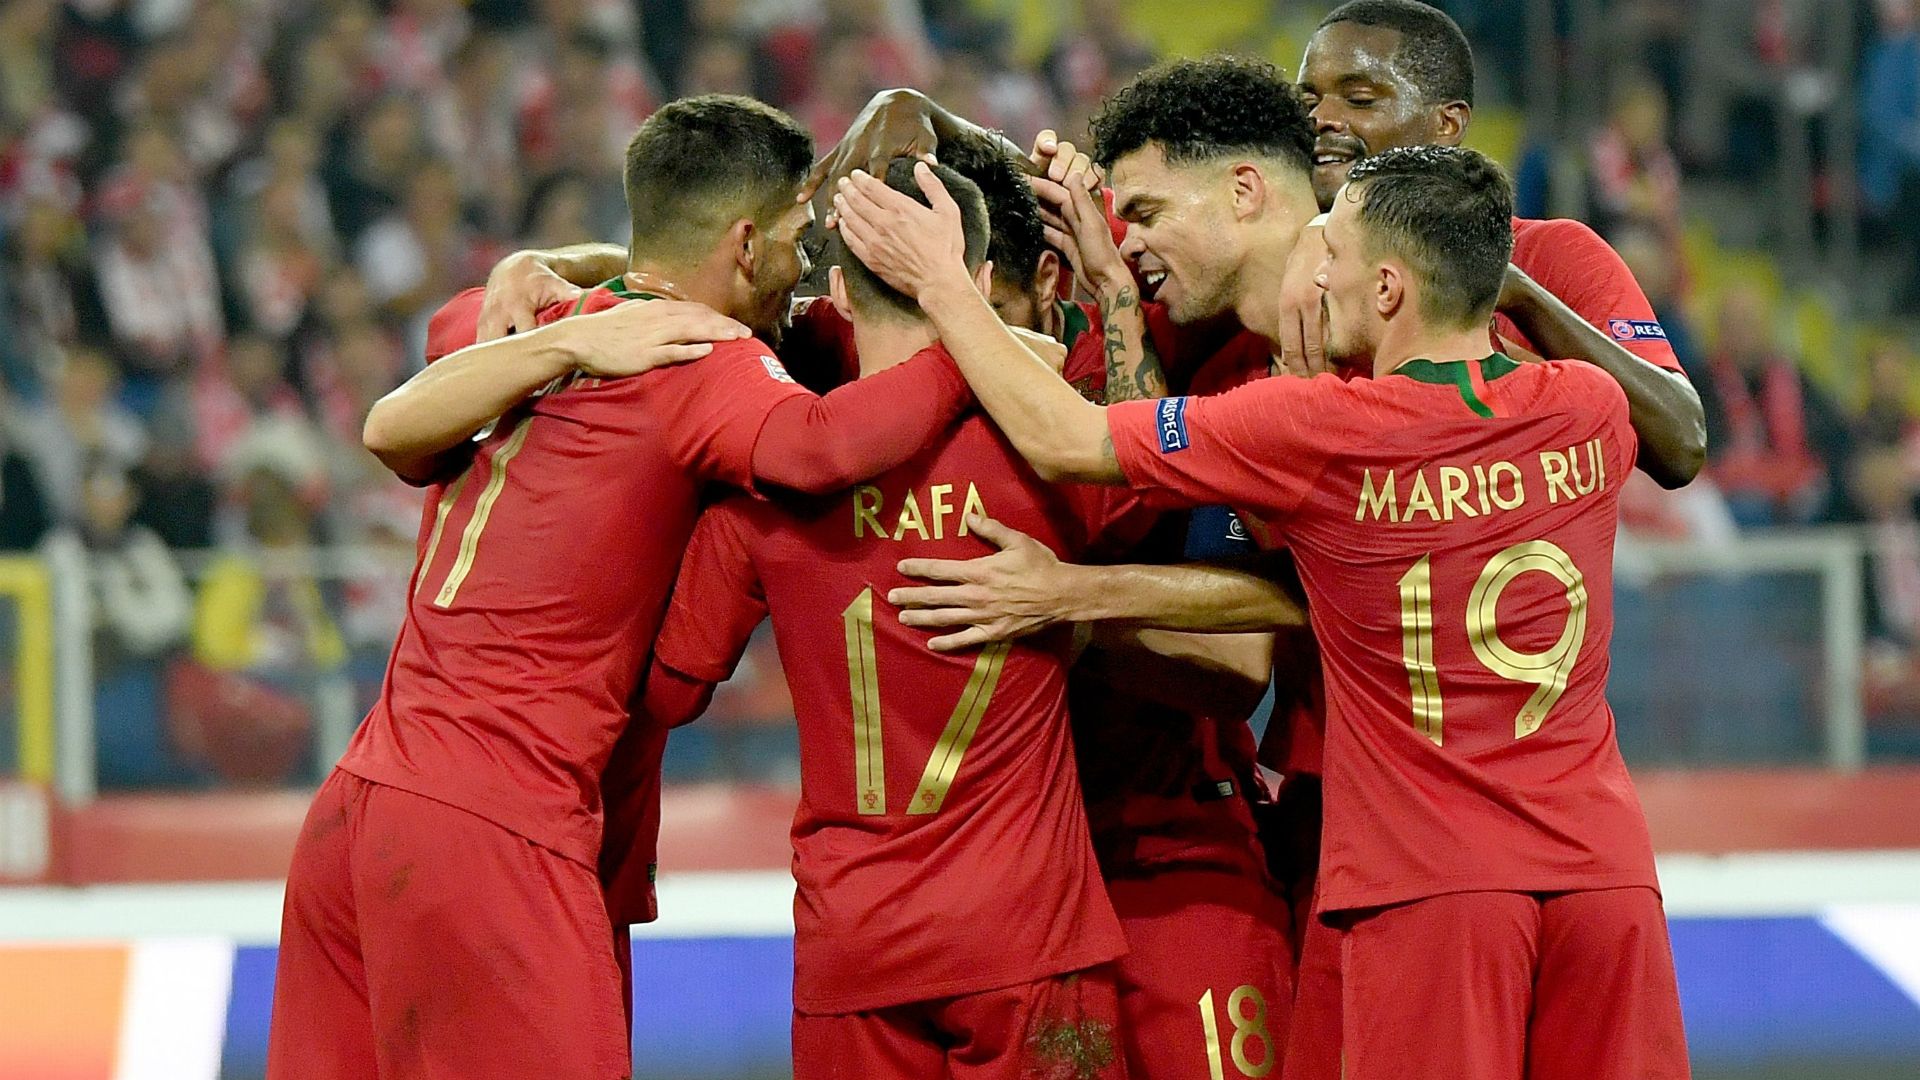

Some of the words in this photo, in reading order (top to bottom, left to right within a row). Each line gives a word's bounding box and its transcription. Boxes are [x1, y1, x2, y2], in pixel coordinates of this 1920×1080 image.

[853, 480, 989, 541] RAFA
[1354, 460, 1525, 523] MARIO
[1539, 438, 1606, 504] RUI
[1396, 539, 1589, 748] 19
[841, 585, 1014, 816] 17
[1198, 984, 1275, 1080] 18
